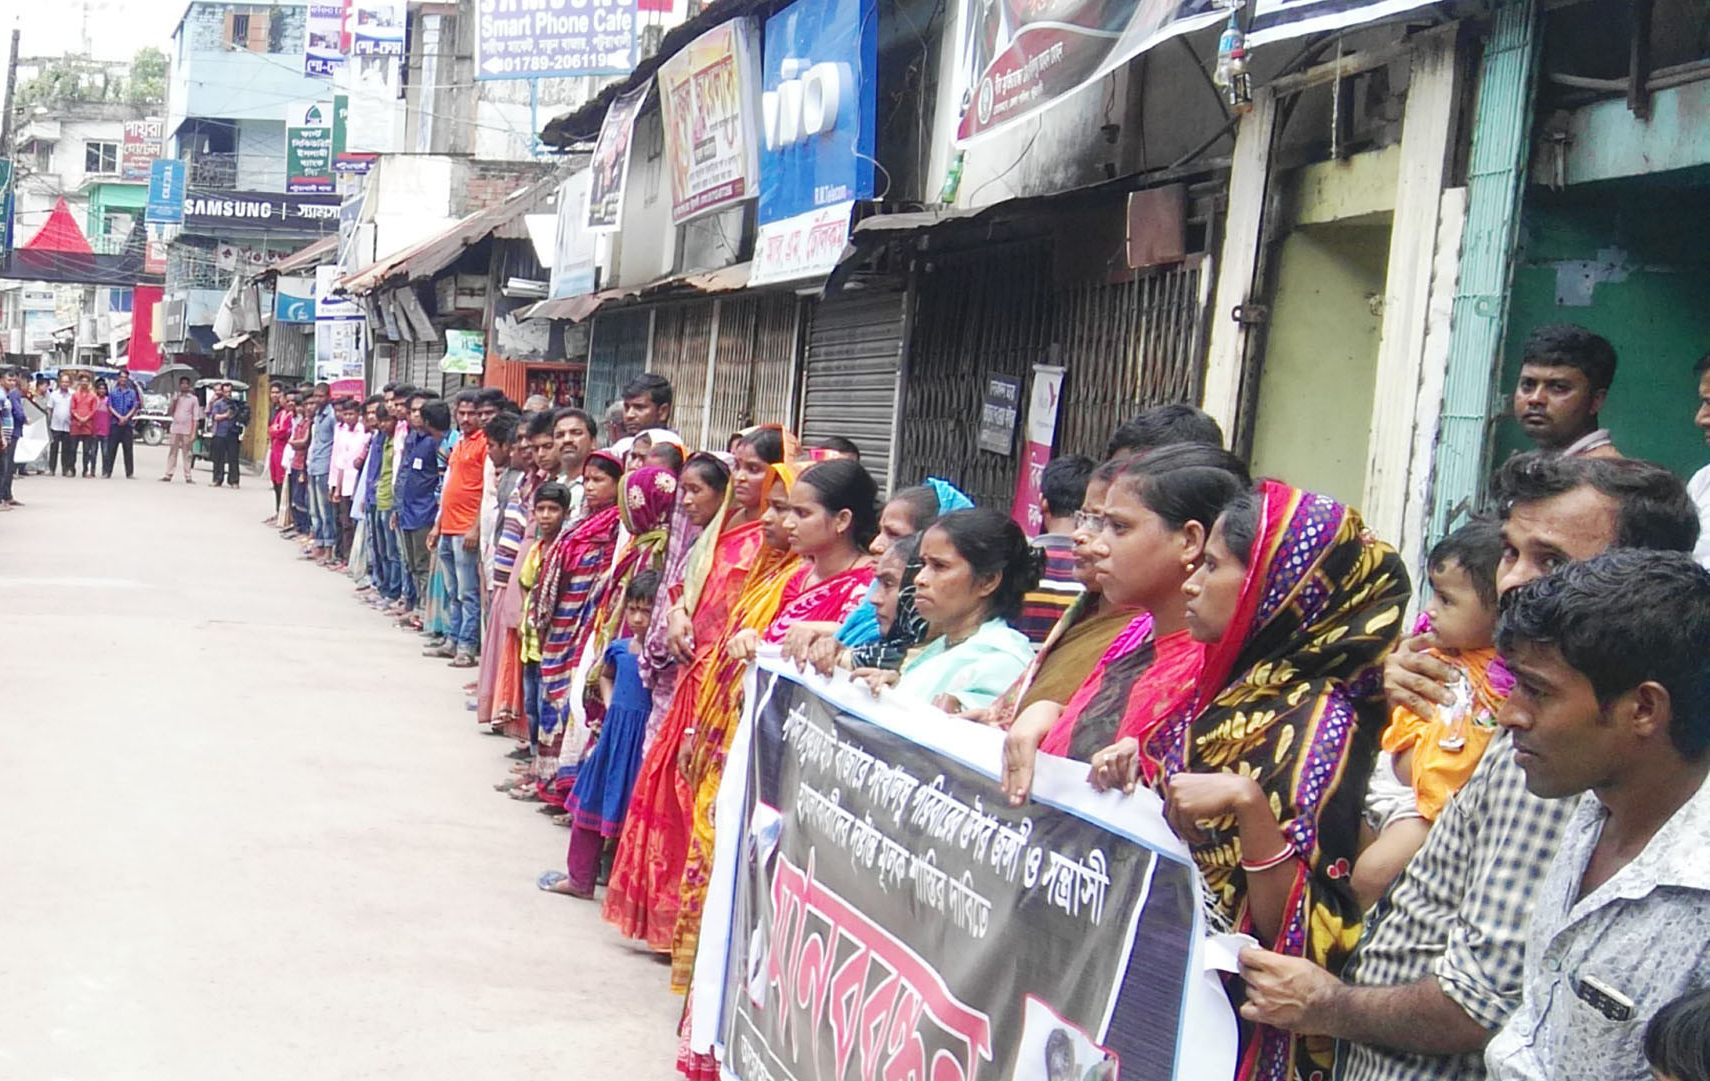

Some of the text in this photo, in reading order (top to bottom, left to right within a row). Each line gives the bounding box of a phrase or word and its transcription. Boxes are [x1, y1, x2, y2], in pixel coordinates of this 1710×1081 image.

[481, 7, 632, 38] Smart Phone Cafe
[124, 122, 162, 139] পায়রা
[184, 199, 272, 219] SAMSUNG
[297, 203, 340, 220] স্যামসা
[1025, 847, 1042, 889] ও
[1041, 848, 1111, 926] সন্ত্রাসী
[948, 879, 992, 940] দাবিতে
